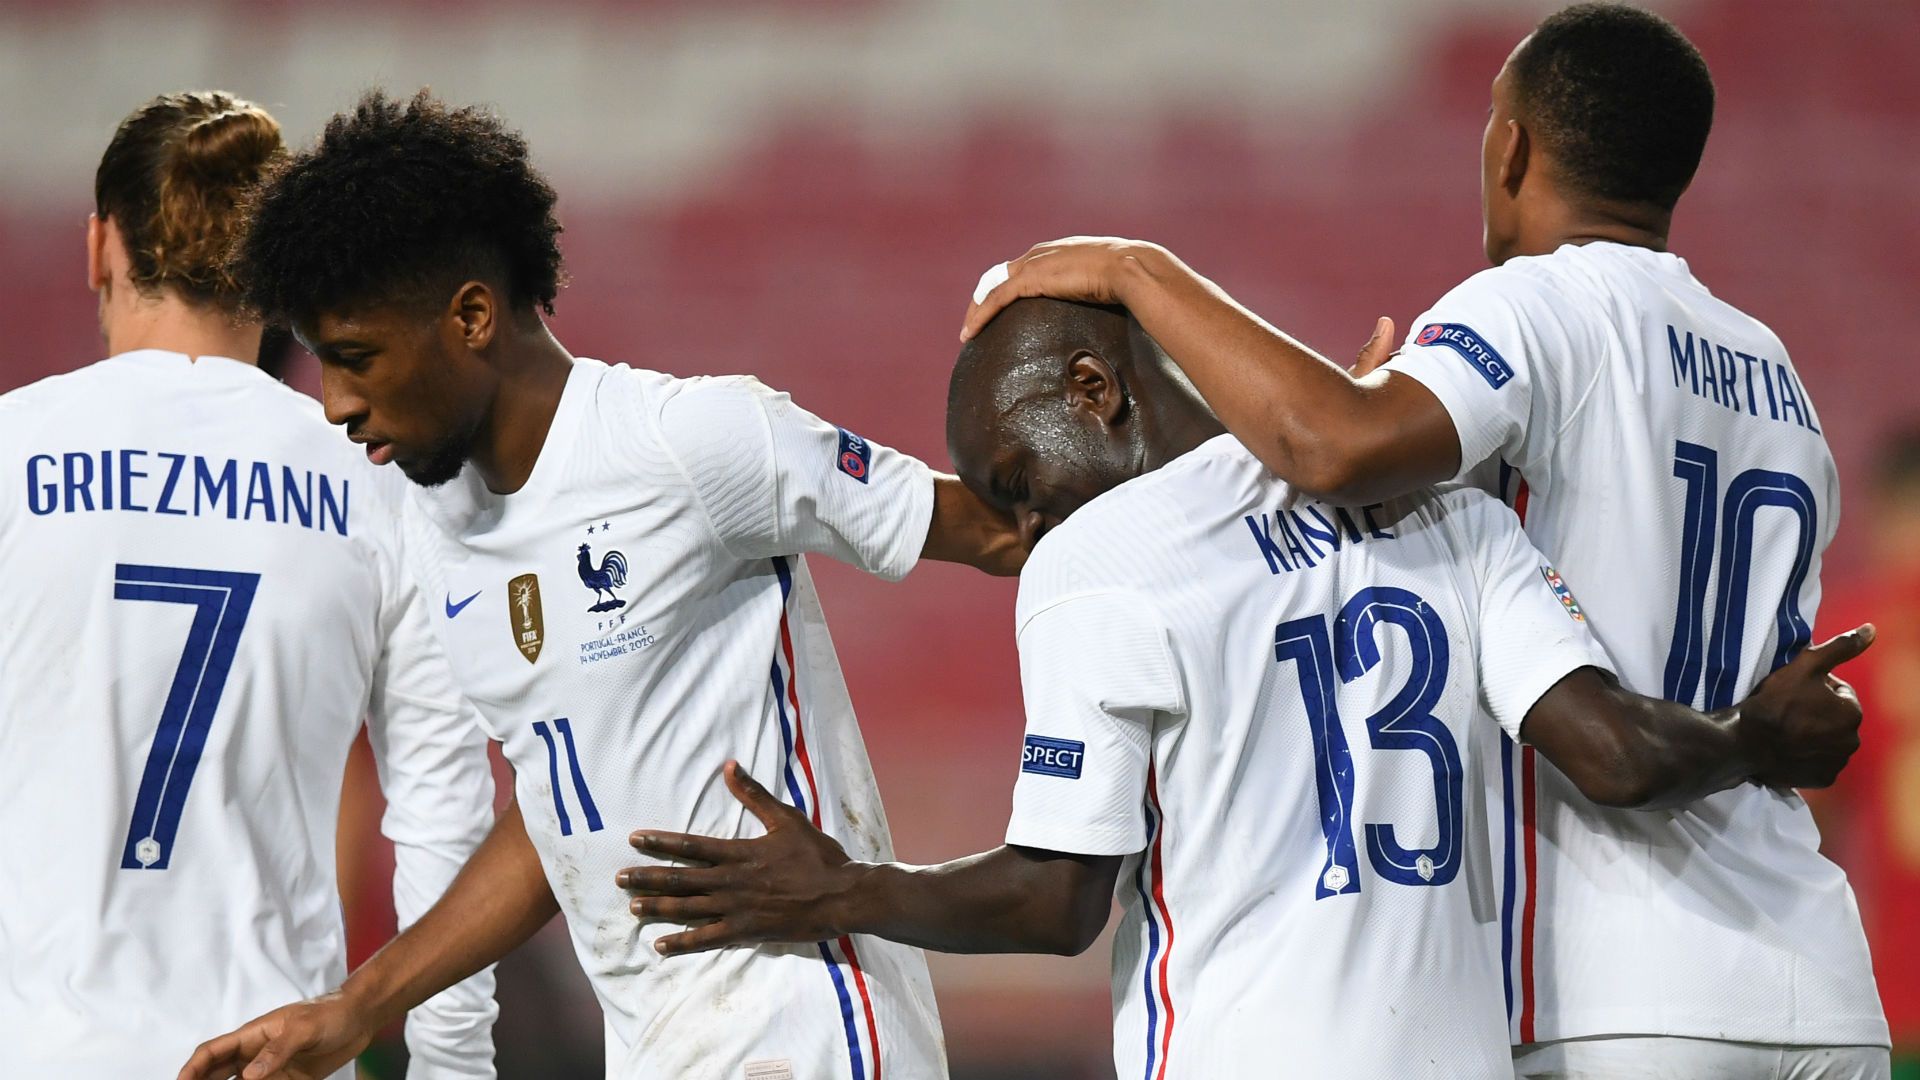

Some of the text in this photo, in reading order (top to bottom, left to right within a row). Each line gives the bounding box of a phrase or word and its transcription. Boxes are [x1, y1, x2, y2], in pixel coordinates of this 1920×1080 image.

[1440, 328, 1509, 382] RESPECT
[1666, 324, 1821, 435] MARTIAL
[26, 449, 349, 537] GRIEZMANN
[1663, 440, 1817, 713] 10
[580, 635, 655, 664] 14 NOVEMBRE 2020
[114, 563, 262, 870] 7
[1023, 745, 1082, 768] SPECT
[1275, 586, 1464, 901] 13
[531, 717, 604, 836] 11
